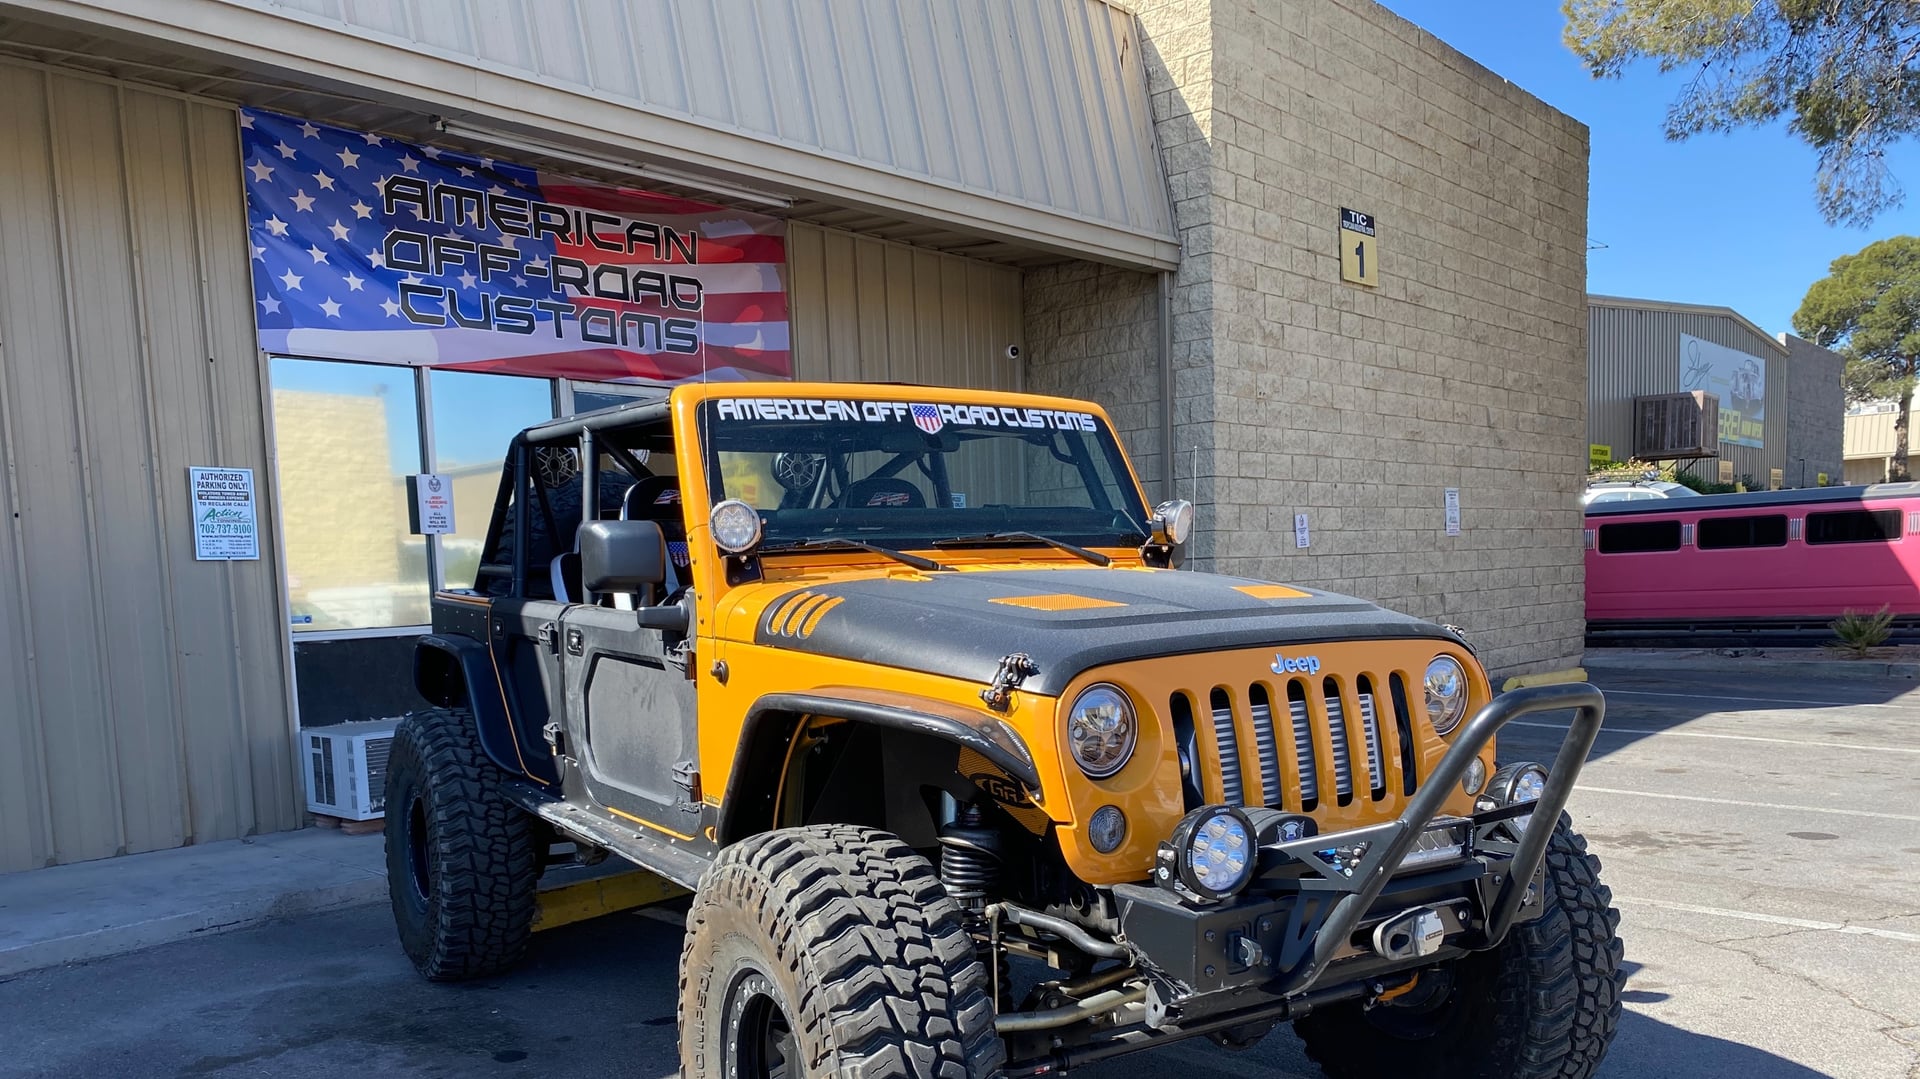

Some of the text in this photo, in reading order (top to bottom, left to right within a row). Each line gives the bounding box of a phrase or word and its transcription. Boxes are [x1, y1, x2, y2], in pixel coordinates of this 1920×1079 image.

[384, 175, 697, 265] AMERICAN
[1349, 211, 1367, 226] TIC
[1355, 241, 1364, 278] 1
[384, 229, 702, 313] OFF-ROAD
[399, 281, 698, 355] CUSTOMS
[717, 399, 1097, 432] AMERICAN OFF ROAD CUSTOMS
[197, 481, 248, 490] PARKING ONLY!
[200, 473, 243, 481] AUTHORIZED
[203, 508, 243, 521] Action
[200, 524, 252, 534] 702-737-9100
[1270, 653, 1320, 675] Jeep
